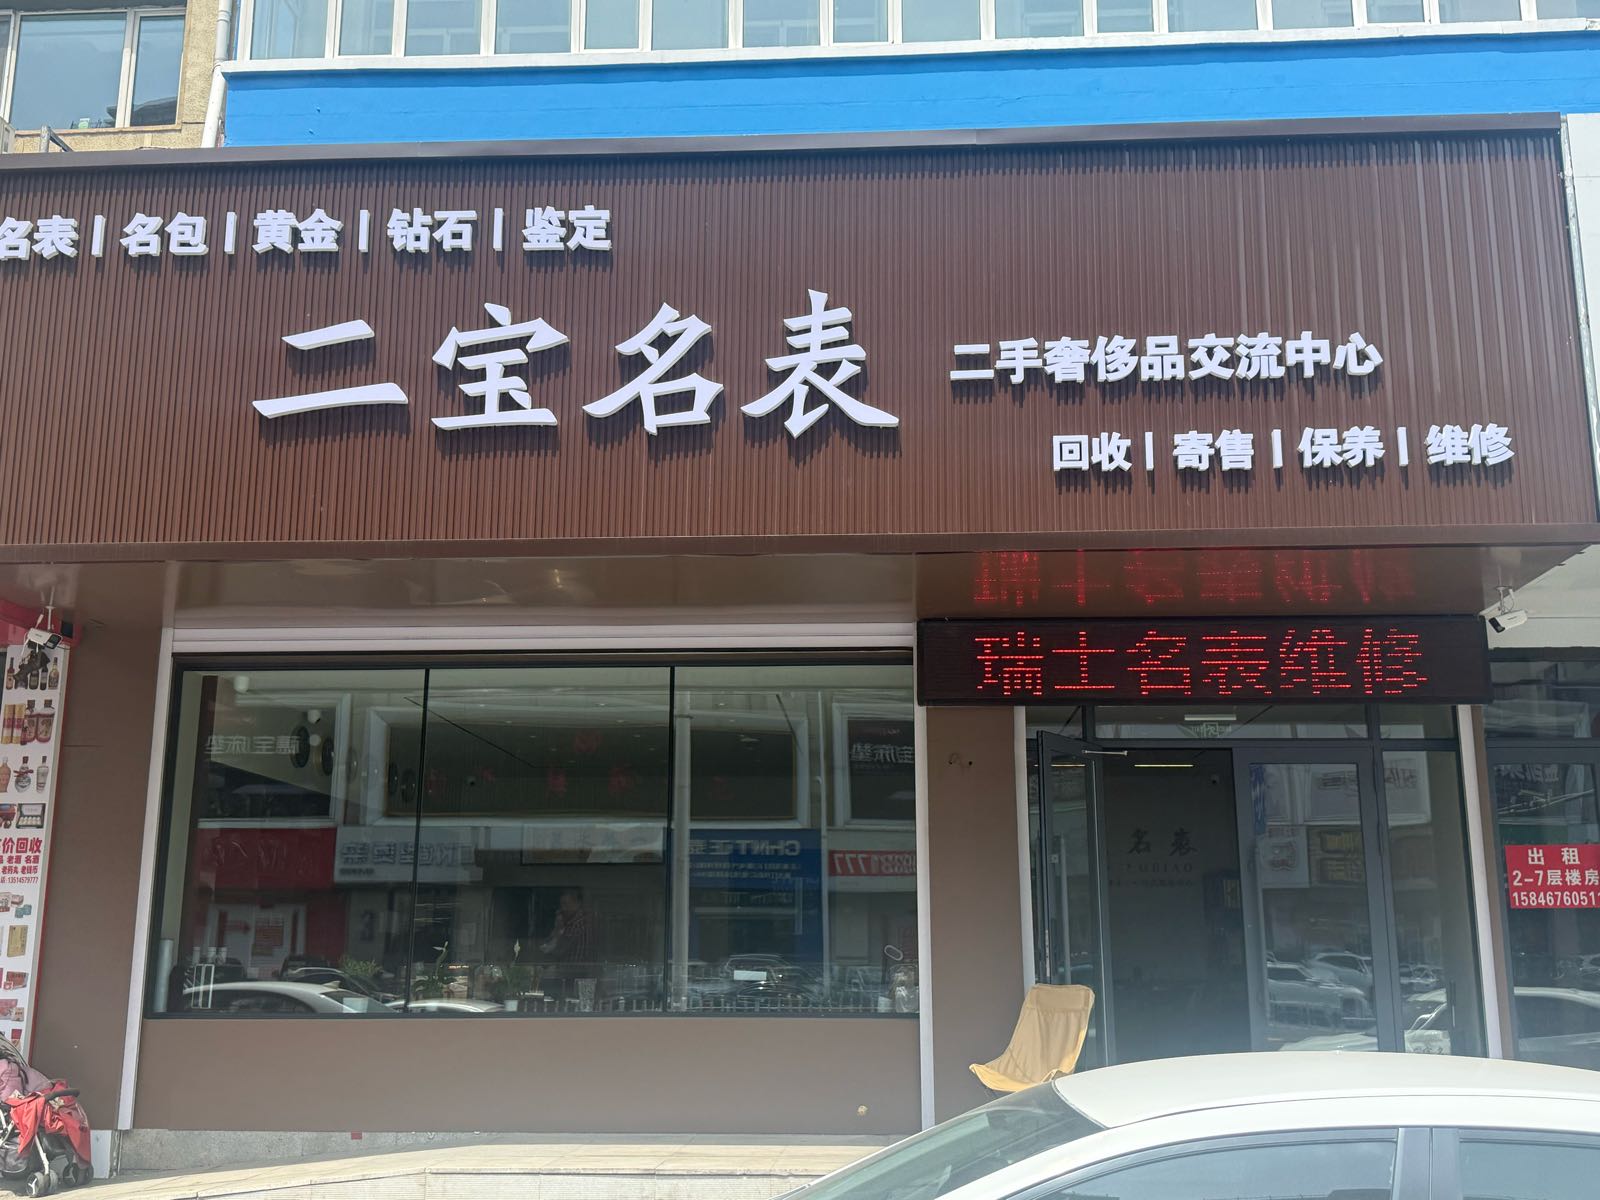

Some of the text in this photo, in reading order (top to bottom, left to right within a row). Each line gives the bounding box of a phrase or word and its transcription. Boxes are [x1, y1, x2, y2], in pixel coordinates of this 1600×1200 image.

[252, 289, 900, 438] 二宝名表
[950, 330, 1384, 385] 二手奢侈品交流中心
[975, 628, 1427, 697] 瑞士名表维修
[0, 837, 42, 853] 价回收
